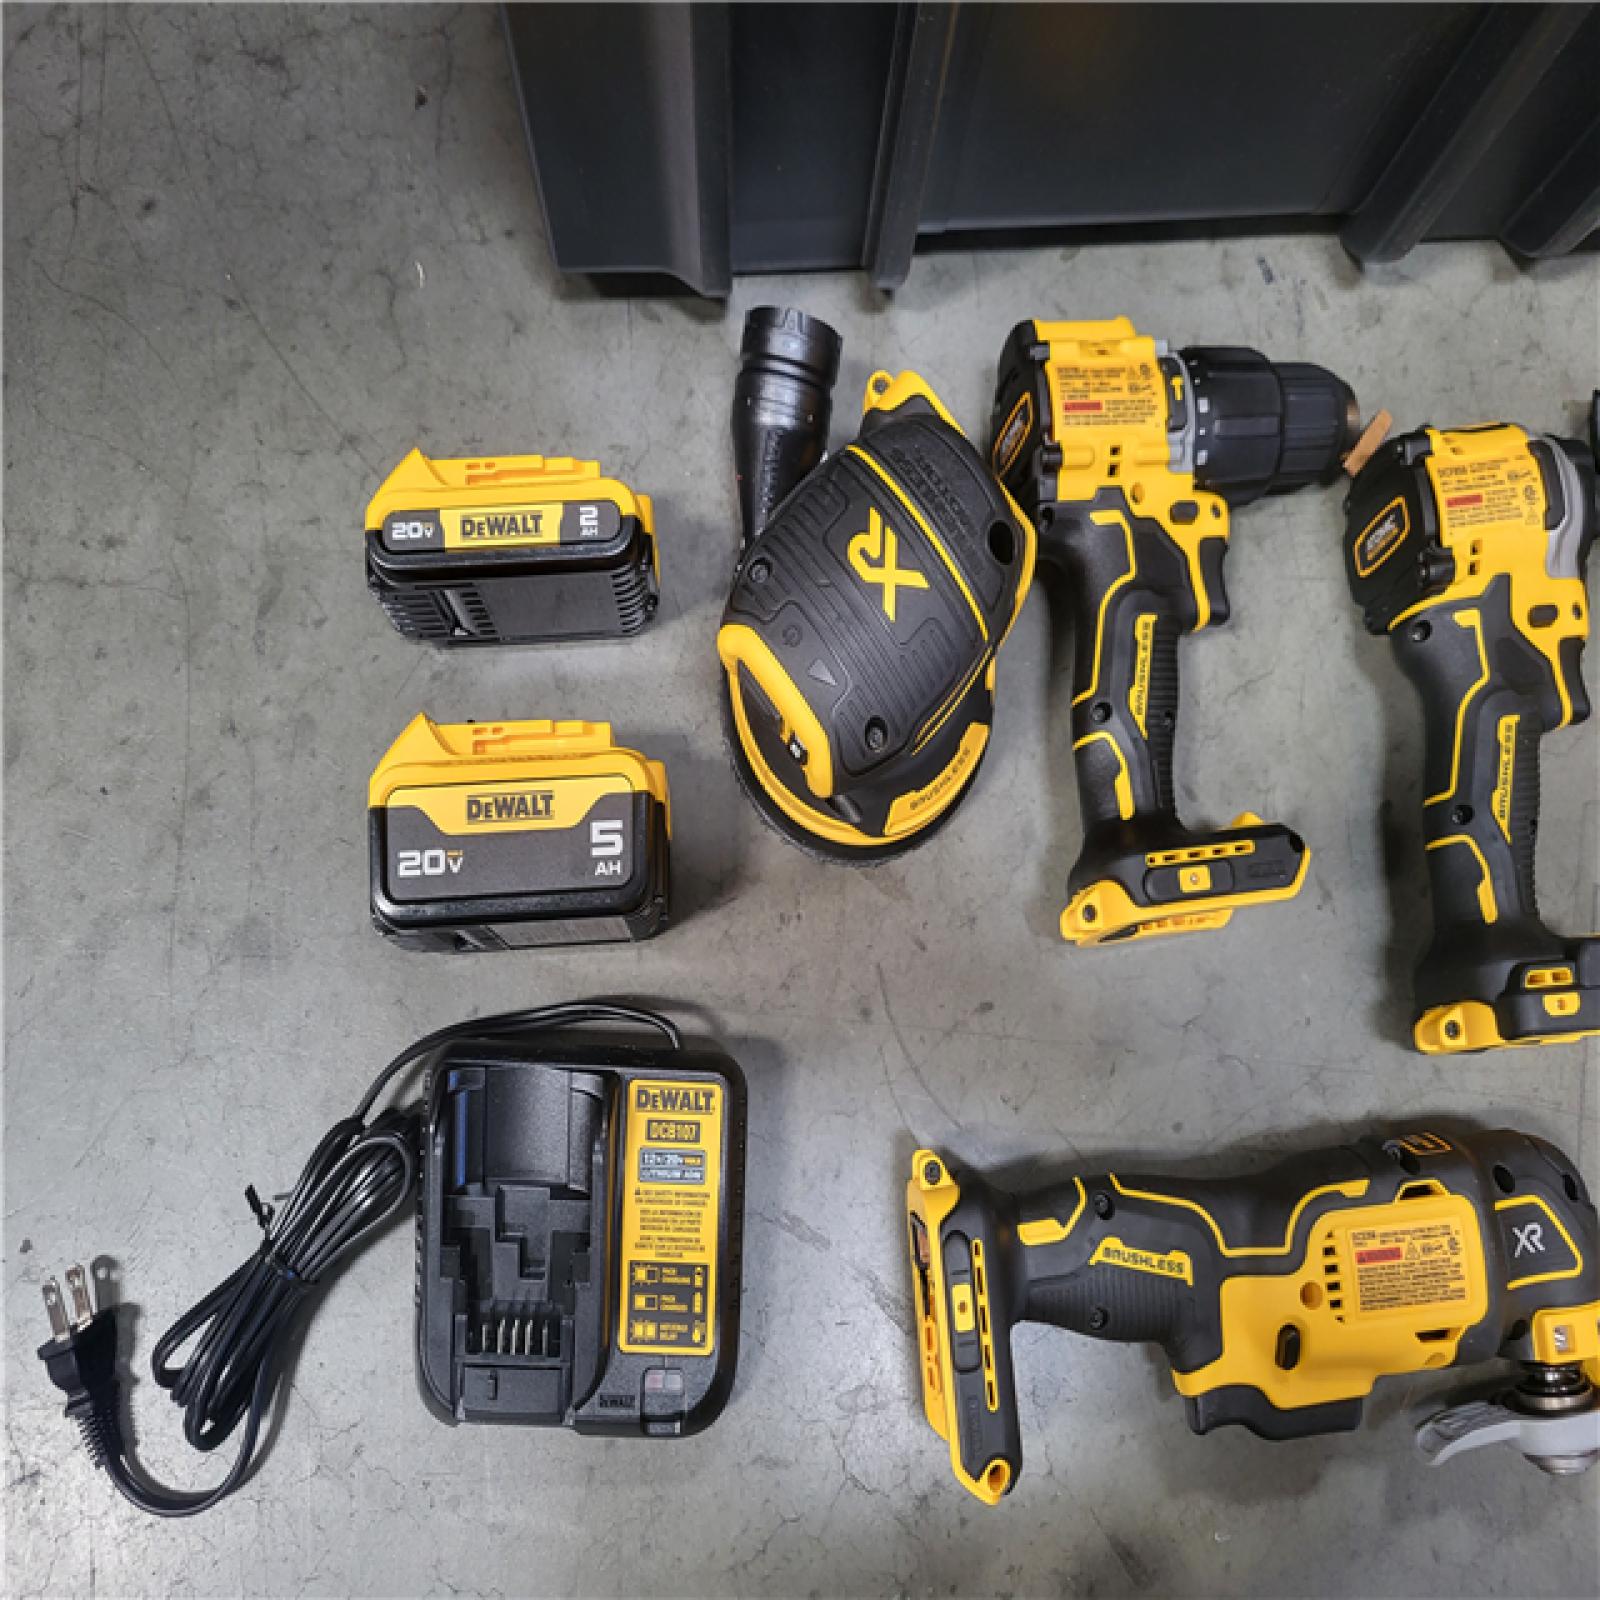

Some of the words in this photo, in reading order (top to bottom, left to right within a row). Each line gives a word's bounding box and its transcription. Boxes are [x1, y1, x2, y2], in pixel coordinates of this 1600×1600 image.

[461, 514, 544, 538] DEWALT
[579, 506, 599, 526] 2
[466, 794, 555, 821] DEWALT
[590, 820, 624, 856] 5
[397, 849, 464, 878] 20V
[595, 859, 621, 876] AH
[637, 1089, 715, 1112] DEWALT
[1511, 1222, 1546, 1258] XR
